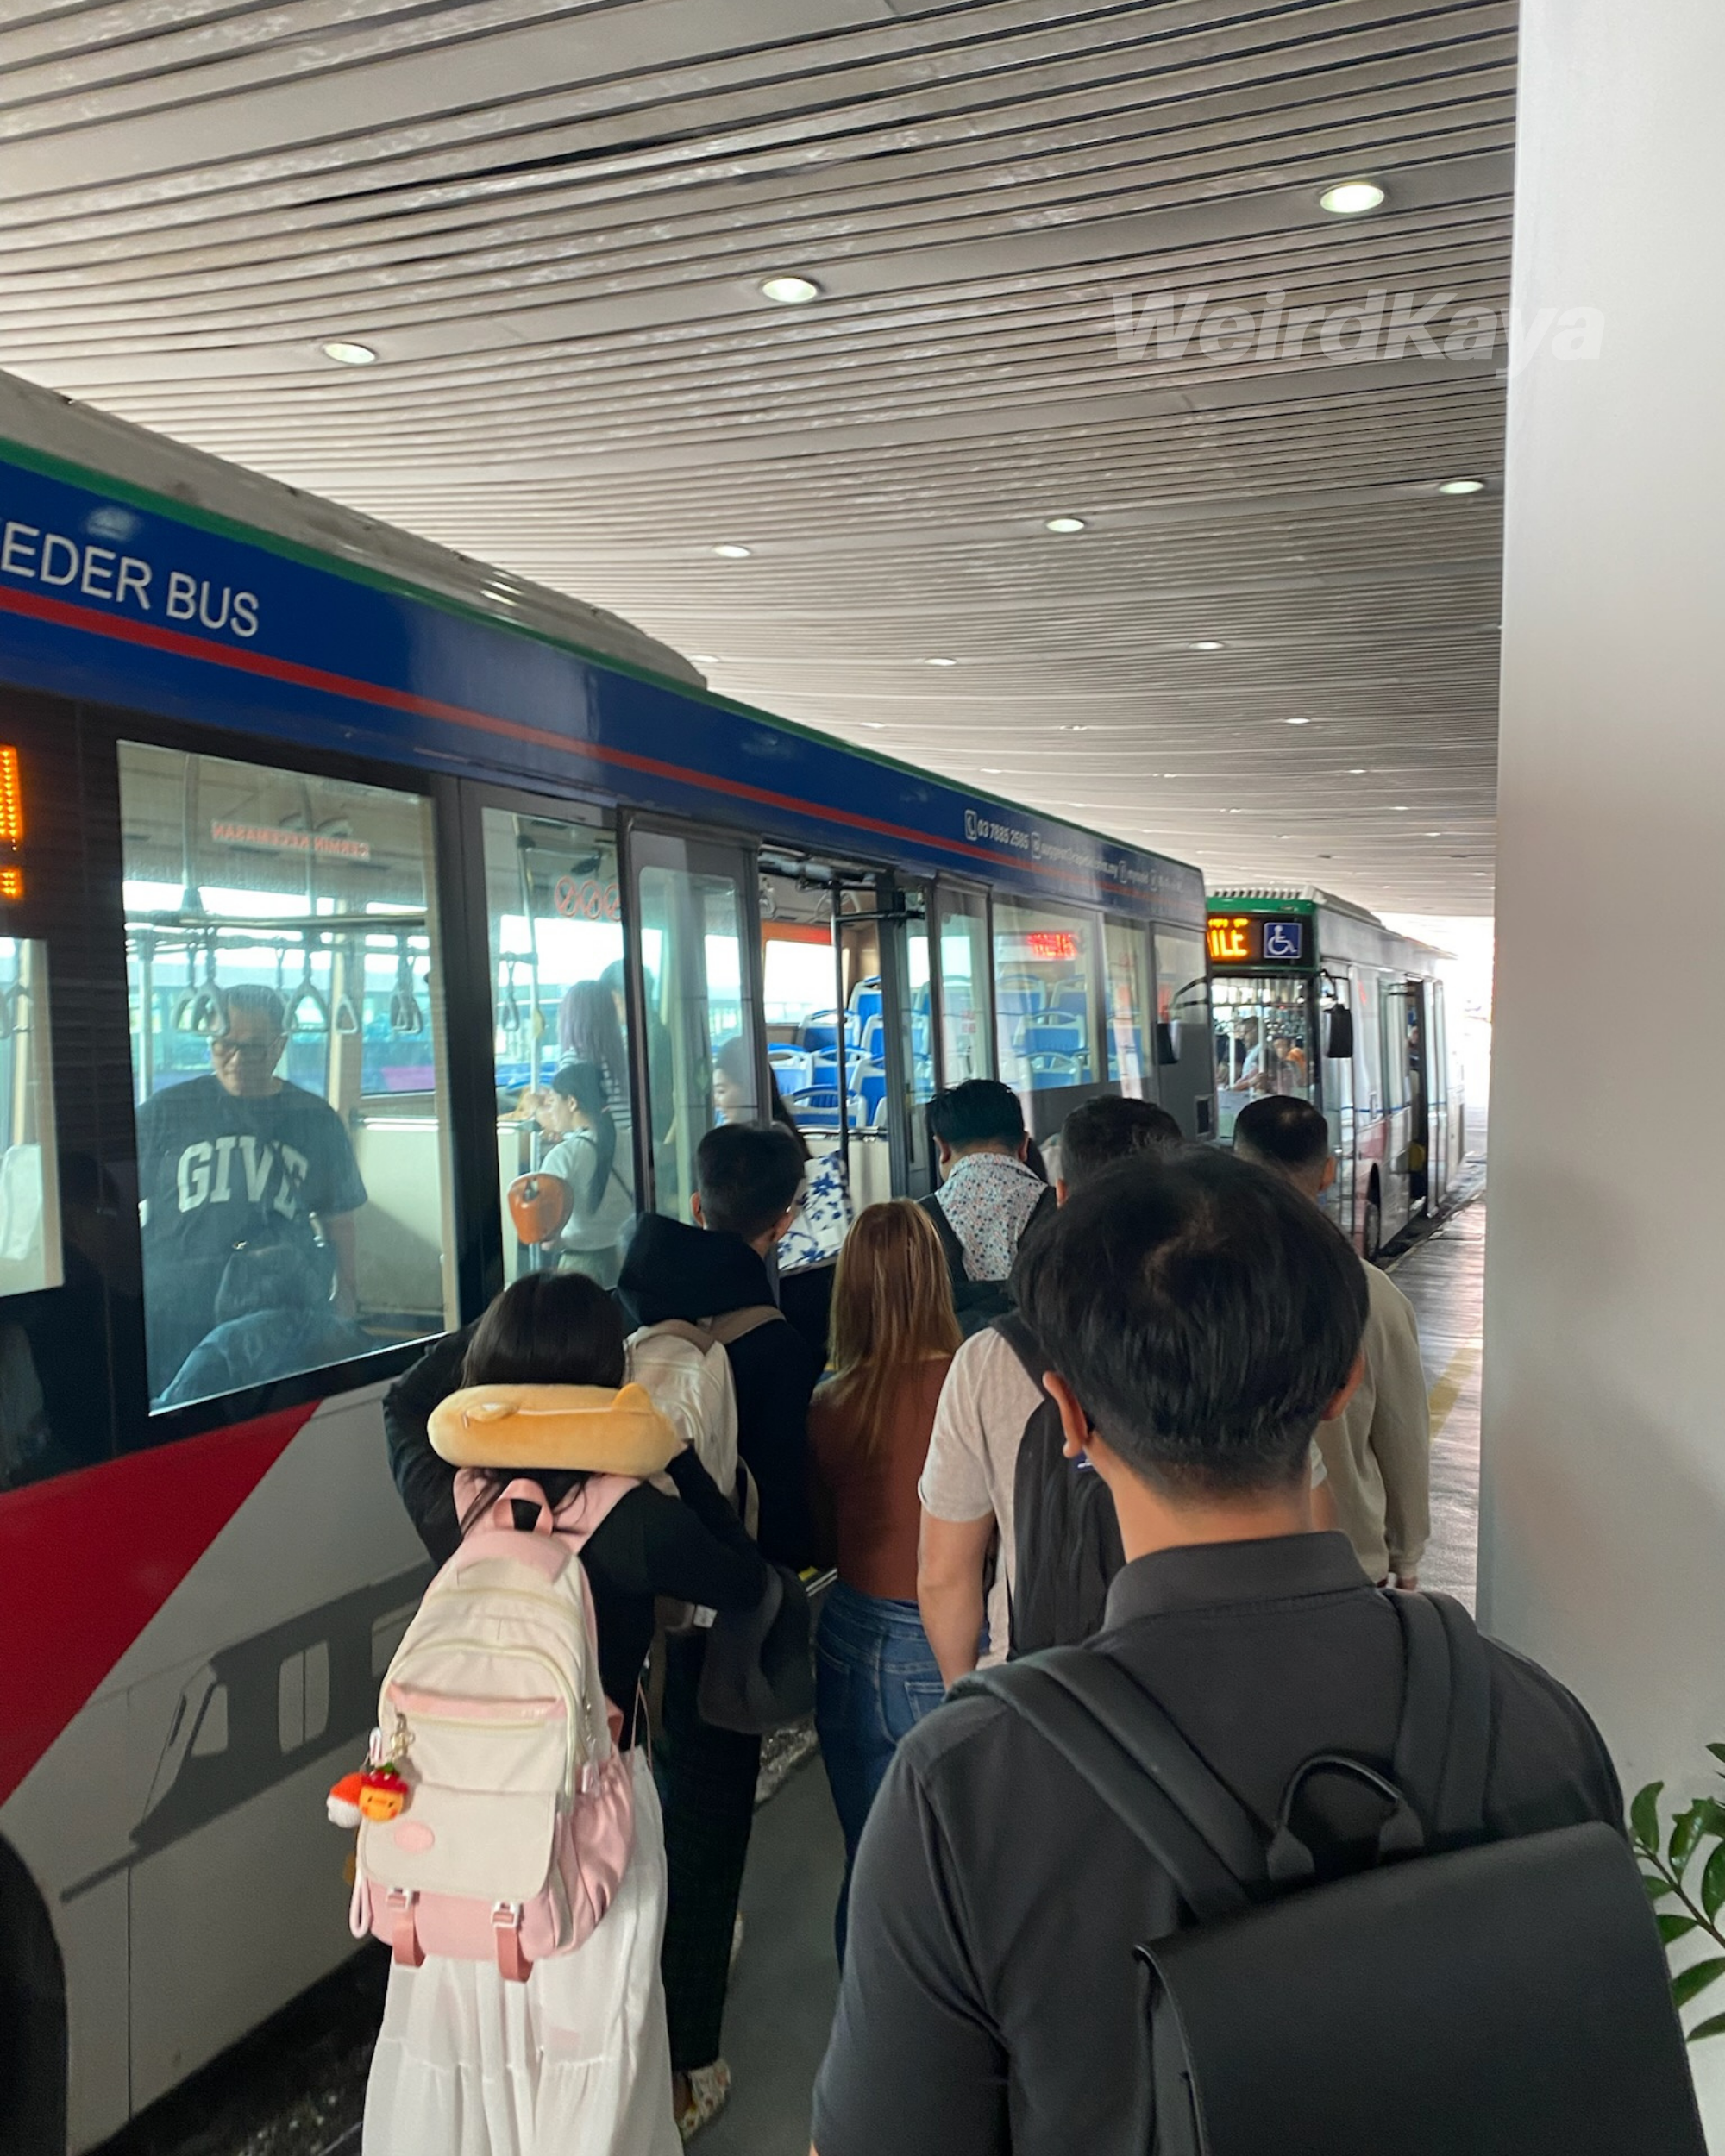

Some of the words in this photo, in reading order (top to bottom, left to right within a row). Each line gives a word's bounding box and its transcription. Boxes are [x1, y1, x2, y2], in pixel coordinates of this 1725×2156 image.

[2, 521, 153, 610] EDER
[166, 571, 258, 637] BUS
[178, 1136, 308, 1220] GIVE
